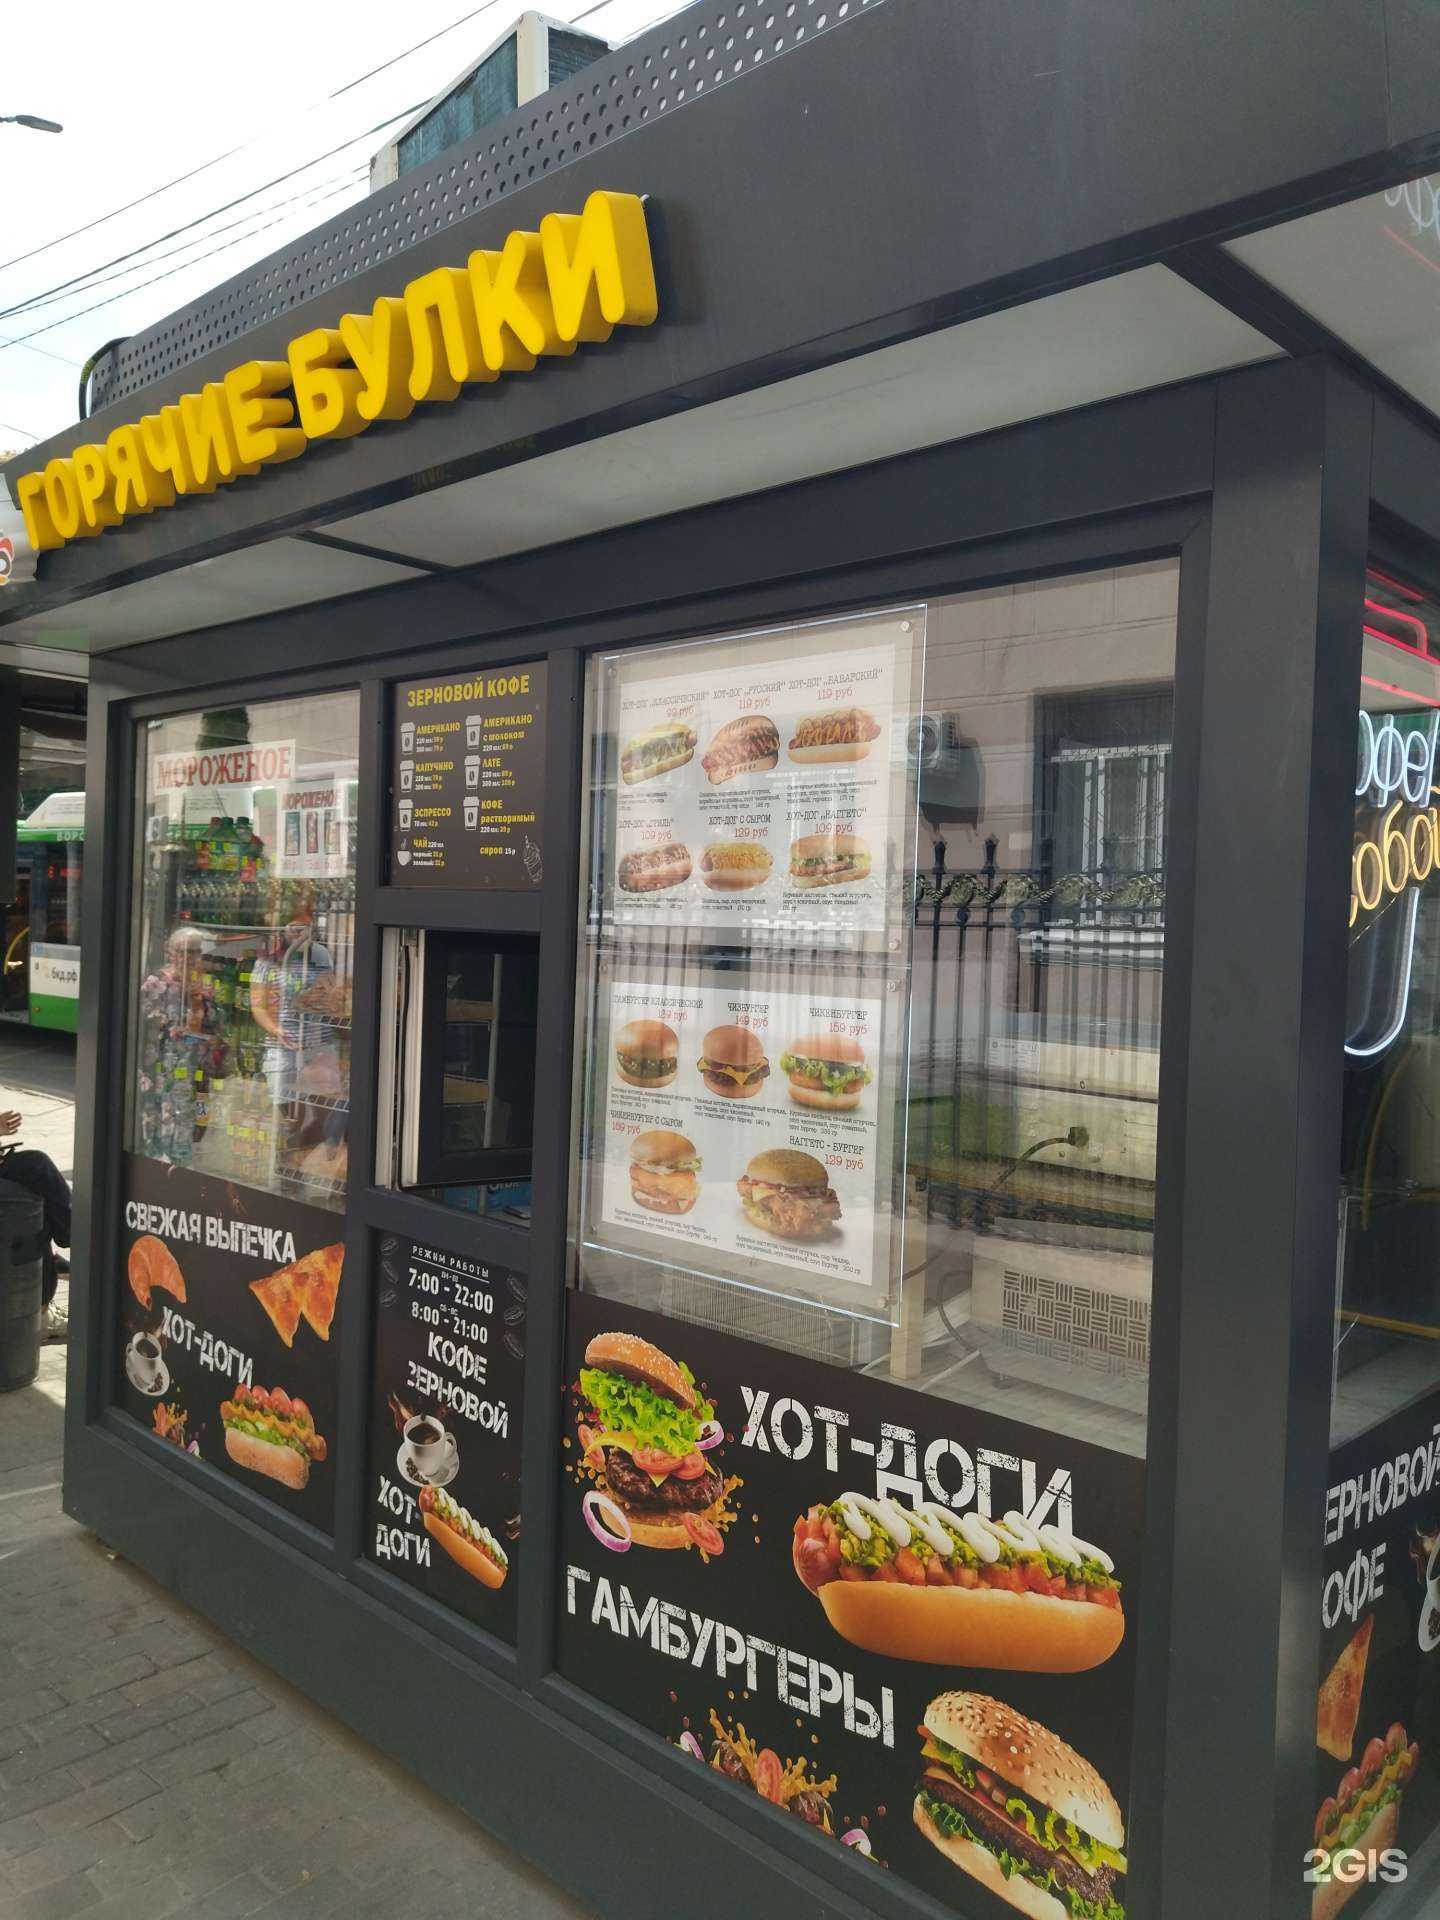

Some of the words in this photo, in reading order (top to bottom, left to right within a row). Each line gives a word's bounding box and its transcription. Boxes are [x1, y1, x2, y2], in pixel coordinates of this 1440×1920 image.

[18, 361, 302, 551] ГОРЯЧИЕ
[288, 190, 658, 440] БУЛКИ
[407, 676, 484, 707] ЗЕРНОВОЙ
[487, 674, 530, 698] КОФЕ
[836, 686, 853, 701] руб
[755, 697, 771, 711] руб
[483, 713, 533, 728] АМЕРИКАНО
[416, 722, 461, 735] АМЕРИКАНО
[157, 747, 291, 790] МОРОЖЕНОЕ
[416, 761, 454, 772] КАПУЧИНО
[481, 799, 503, 810] КОФЕ
[414, 807, 452, 819] ЭСПРЕССО
[480, 811, 536, 827] растворимый
[708, 815, 738, 826] ХОТ-ДОГ
[746, 813, 771, 824] СЫРОМ
[658, 829, 672, 841] руб
[752, 825, 769, 839] руб
[815, 823, 832, 834] 109
[836, 821, 853, 836] руб
[413, 836, 428, 850] ЧАЙ
[480, 846, 503, 857] сироп
[728, 1002, 769, 1014] ЧИЗБУРГЕР
[809, 1007, 868, 1020] ЧИКЕНБУРГЕР
[753, 1016, 769, 1028] руб
[849, 1023, 868, 1037] руб
[627, 1124, 641, 1136] руб
[661, 1116, 683, 1129] СЫРОМ
[789, 1135, 825, 1149] НАГГЕТС
[832, 1142, 865, 1155] БУРГЕР
[846, 1157, 864, 1170] руб
[125, 1201, 201, 1243] СВЕЖАЯ
[206, 1215, 297, 1264] ВЫПЕЧКА
[412, 1245, 446, 1264] РЕЖИМ
[450, 1257, 490, 1278] РАБОТЫ
[408, 1267, 440, 1296] 7:00
[454, 1283, 494, 1315] 22:00
[411, 1301, 441, 1326] 8:00
[453, 1316, 489, 1345] 21:00
[162, 1305, 254, 1389] ХОТ-ДОГИ
[427, 1331, 488, 1385] КОФЕ
[406, 1360, 508, 1439] ЗЕРНОВОЙ
[739, 1385, 1074, 1538] ХОТ-ДОГИ
[375, 1523, 432, 1568] ДОГИ
[1322, 1542, 1387, 1629] ОФЕ
[566, 1564, 896, 1749] ГАМБУРГЕРЫ
